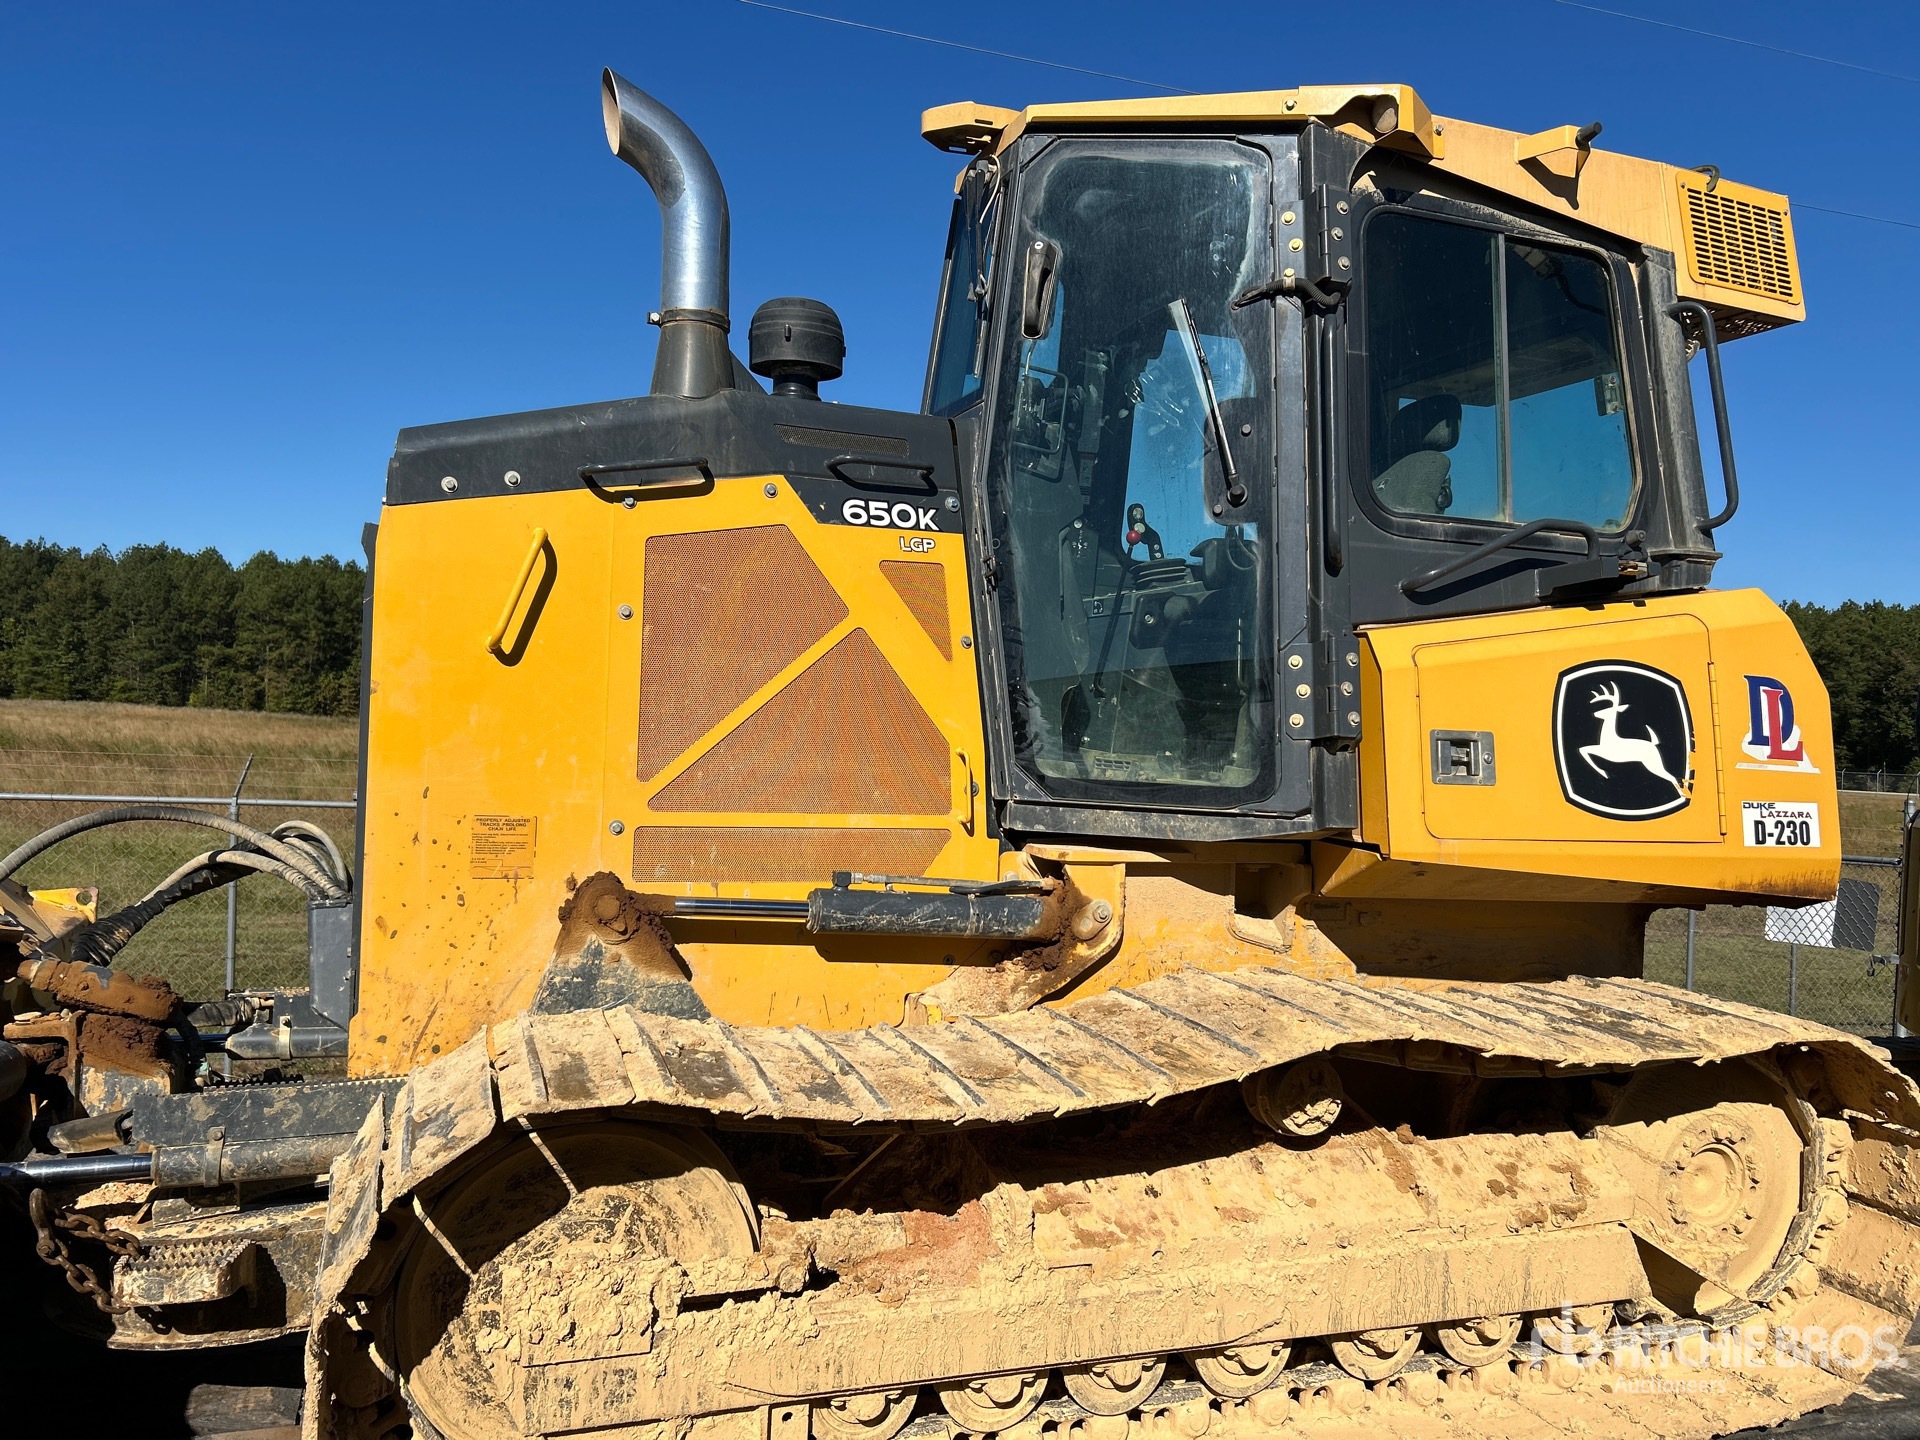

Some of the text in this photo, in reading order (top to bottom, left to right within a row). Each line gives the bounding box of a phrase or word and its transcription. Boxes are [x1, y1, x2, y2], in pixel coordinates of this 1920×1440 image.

[842, 499, 940, 531] 650K
[899, 536, 935, 553] LGP
[1742, 802, 1776, 811] DUKE
[1760, 811, 1813, 819] LAZZARA
[1753, 820, 1811, 846] D-230
